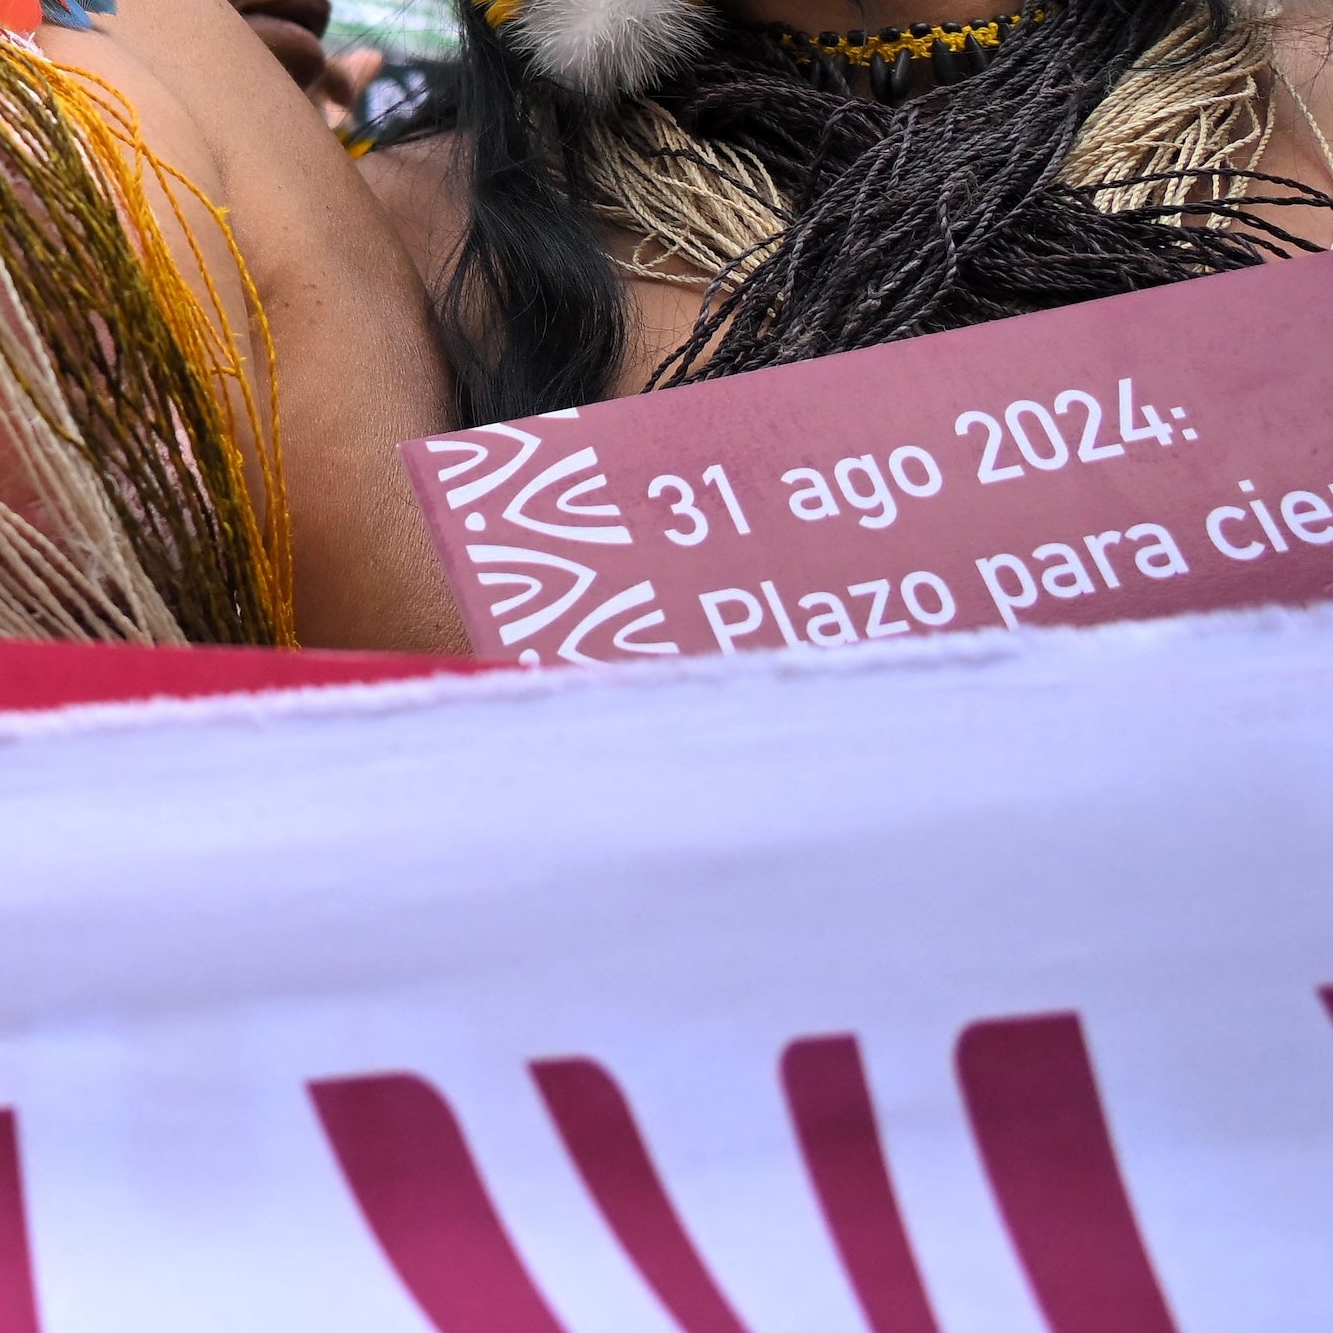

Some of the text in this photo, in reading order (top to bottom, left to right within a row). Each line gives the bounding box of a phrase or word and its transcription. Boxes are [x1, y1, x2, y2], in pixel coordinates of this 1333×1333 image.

[647, 377, 1198, 547] 31 ago 2024:
[698, 479, 1333, 656] Plazo para cie
